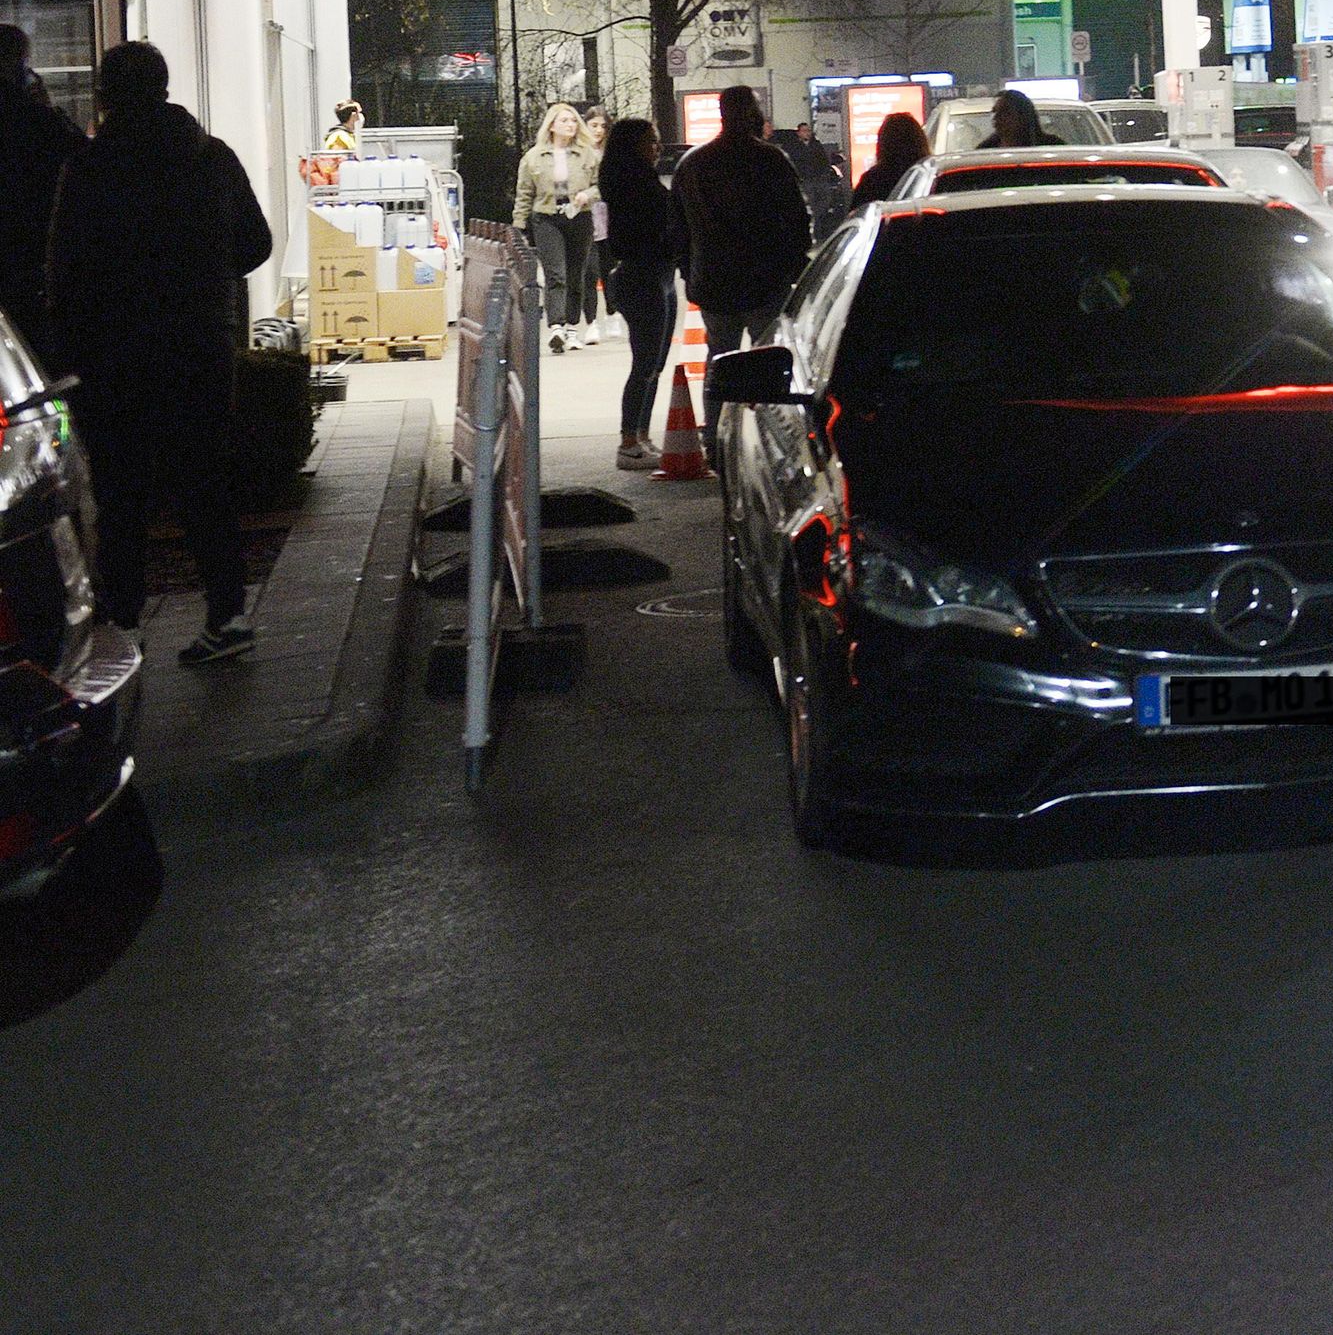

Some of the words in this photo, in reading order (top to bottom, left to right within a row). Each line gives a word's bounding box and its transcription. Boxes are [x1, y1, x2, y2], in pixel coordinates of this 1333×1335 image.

[710, 25, 749, 38] OMV
[1325, 45, 1333, 58] 3
[1218, 70, 1226, 81] 2
